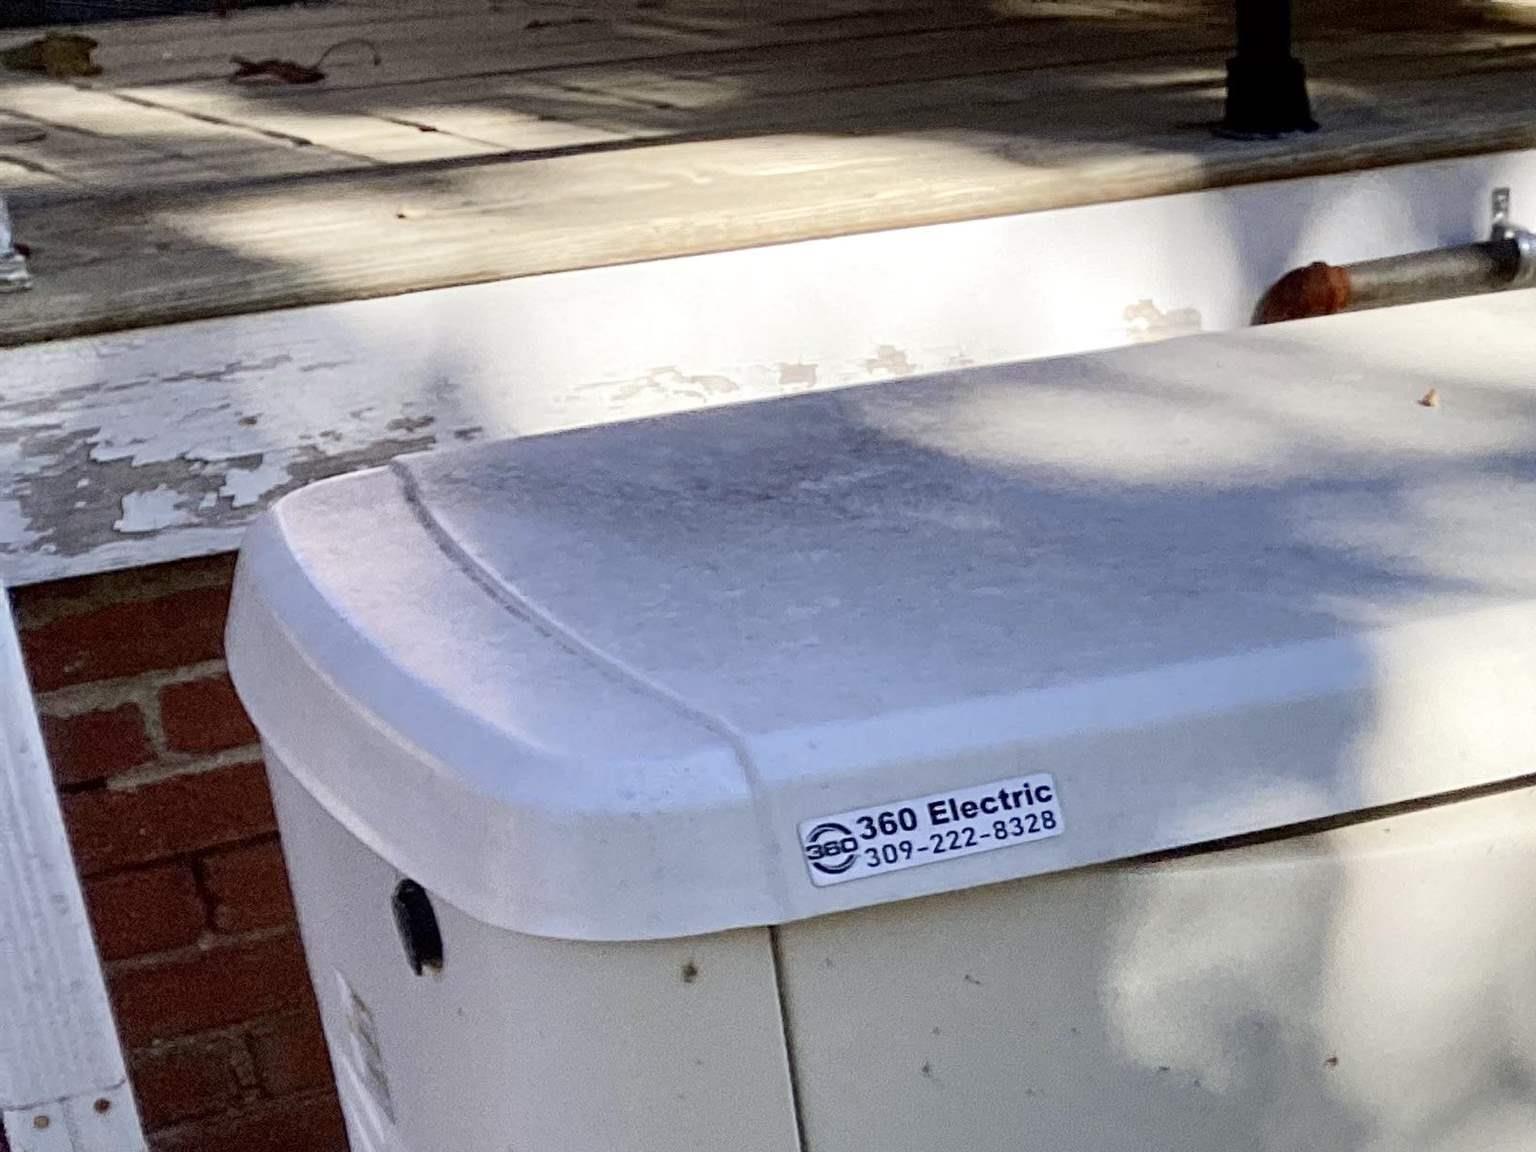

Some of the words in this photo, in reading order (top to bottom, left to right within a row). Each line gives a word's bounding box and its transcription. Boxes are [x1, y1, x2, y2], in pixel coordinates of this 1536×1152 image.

[856, 807, 918, 841] 360
[927, 783, 1054, 826] Electric
[865, 810, 1058, 868] 309-222-8328
[805, 837, 859, 861] 360
